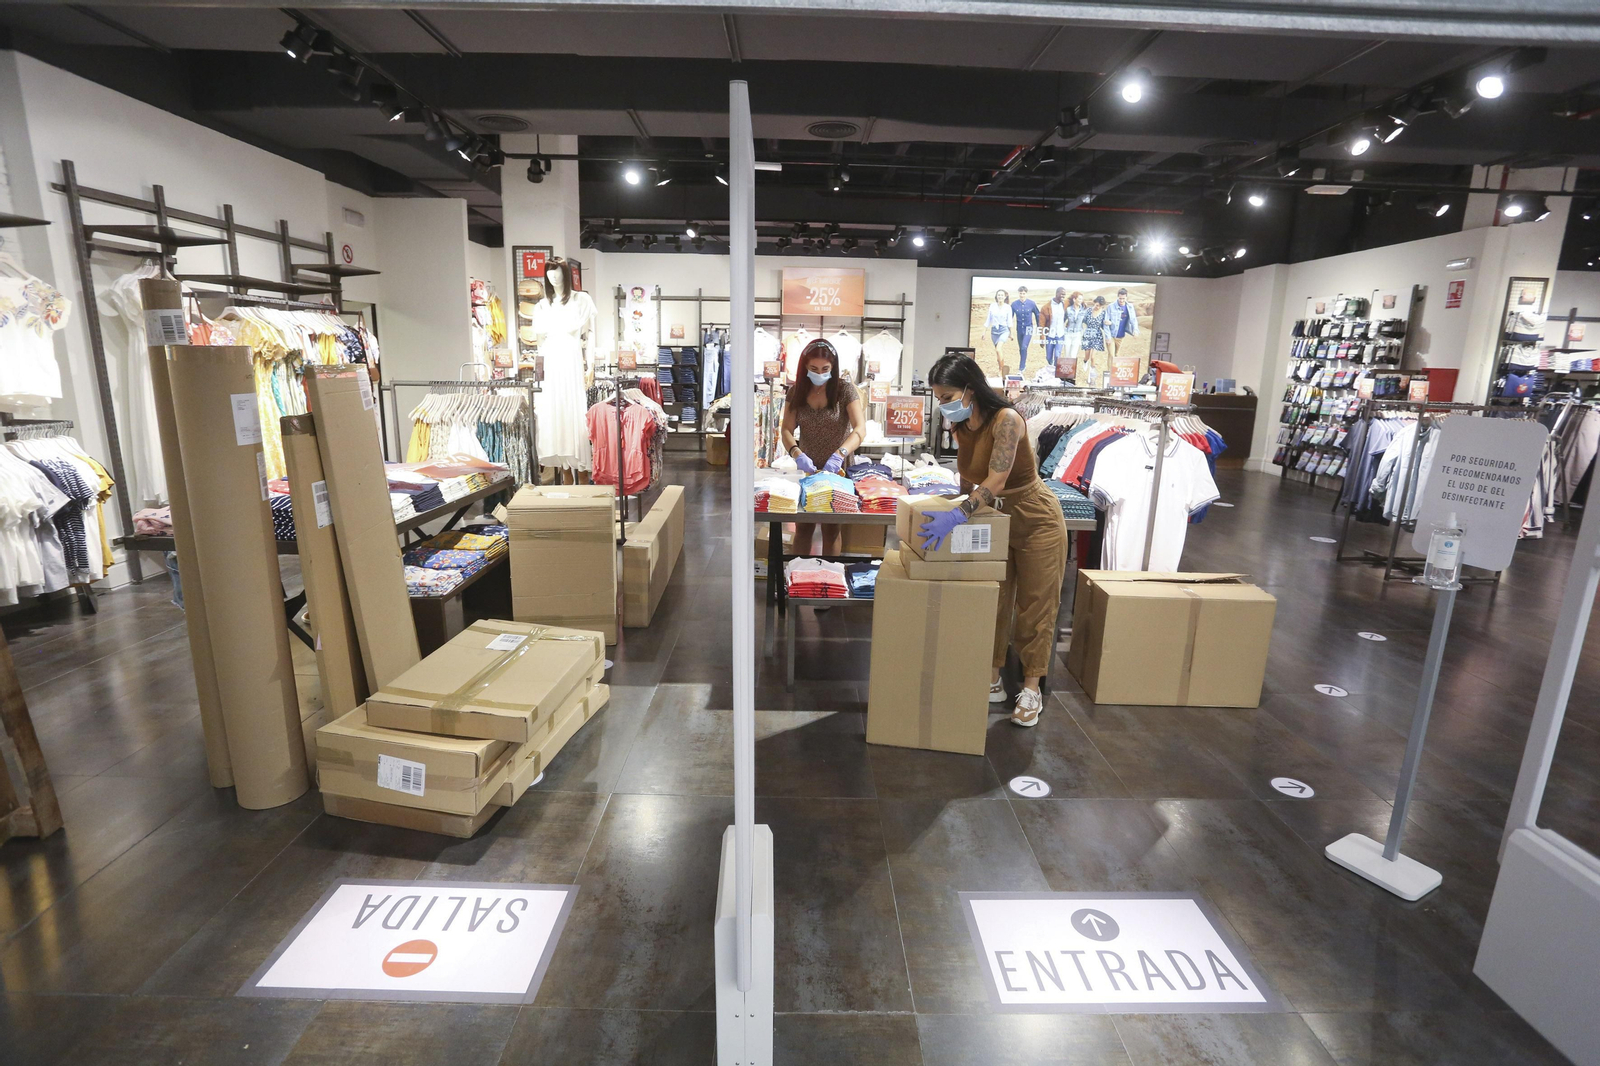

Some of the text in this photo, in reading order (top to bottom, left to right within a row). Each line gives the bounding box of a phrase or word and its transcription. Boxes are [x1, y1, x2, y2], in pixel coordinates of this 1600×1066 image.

[526, 259, 538, 271] 14
[806, 286, 841, 306] -25%
[1115, 367, 1134, 378] -25%
[1164, 384, 1186, 398] -25%
[890, 410, 918, 425] -25%
[1450, 454, 1467, 463] POR
[1442, 465, 1522, 485] TE RECOMENDAMOS
[1447, 480, 1505, 497] EL USO DE GEL
[1441, 492, 1506, 510] DESINFECTANTE
[351, 894, 529, 933] SALIDA
[994, 949, 1249, 992] ENTRADA
